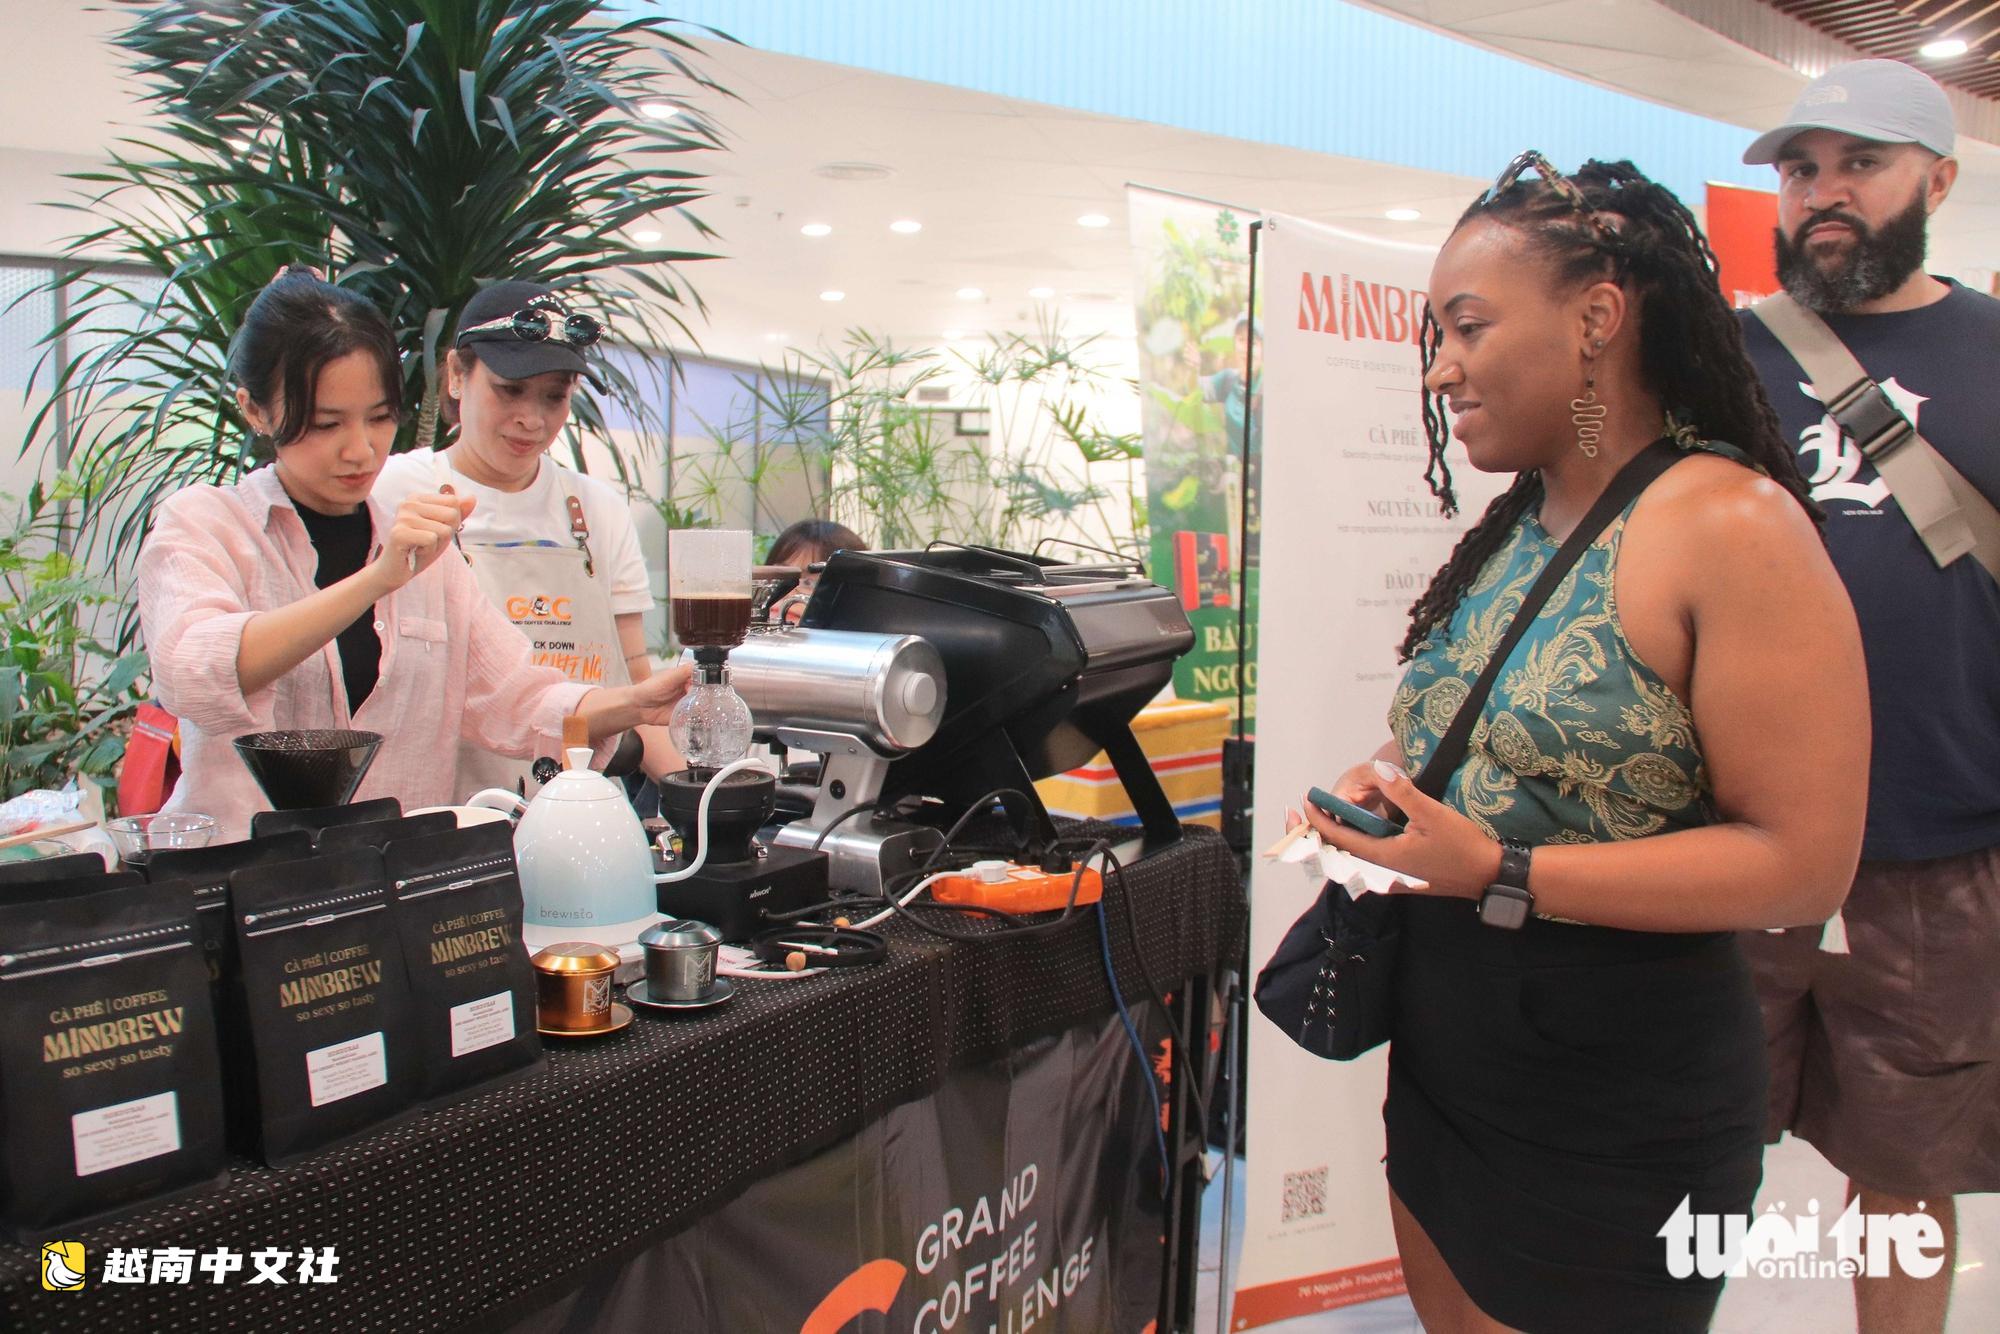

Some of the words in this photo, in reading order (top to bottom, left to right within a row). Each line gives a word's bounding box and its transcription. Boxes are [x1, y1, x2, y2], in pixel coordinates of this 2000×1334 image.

[1297, 271, 1435, 347] MINBR
[533, 641, 546, 650] CK
[549, 641, 575, 650] DOWN
[432, 921, 446, 934] CÀ
[471, 908, 506, 925] COFFEE
[540, 905, 593, 919] brewista
[284, 959, 301, 973] CÀ
[329, 944, 370, 963] COFFEE
[280, 960, 382, 1008] MINBREW
[50, 1007, 70, 1024] CÀ
[73, 1001, 104, 1019] PHÊ
[112, 990, 168, 1010] COFFEE
[296, 1012, 311, 1022] so
[338, 1001, 350, 1011] so
[43, 1006, 184, 1063] MINBREW
[63, 1067, 81, 1078] so
[84, 1058, 117, 1073] sexy
[121, 1053, 136, 1065] so
[140, 1044, 173, 1060] tasty
[916, 1163, 1038, 1276] GRAND
[913, 1220, 1038, 1334] COFFEE
